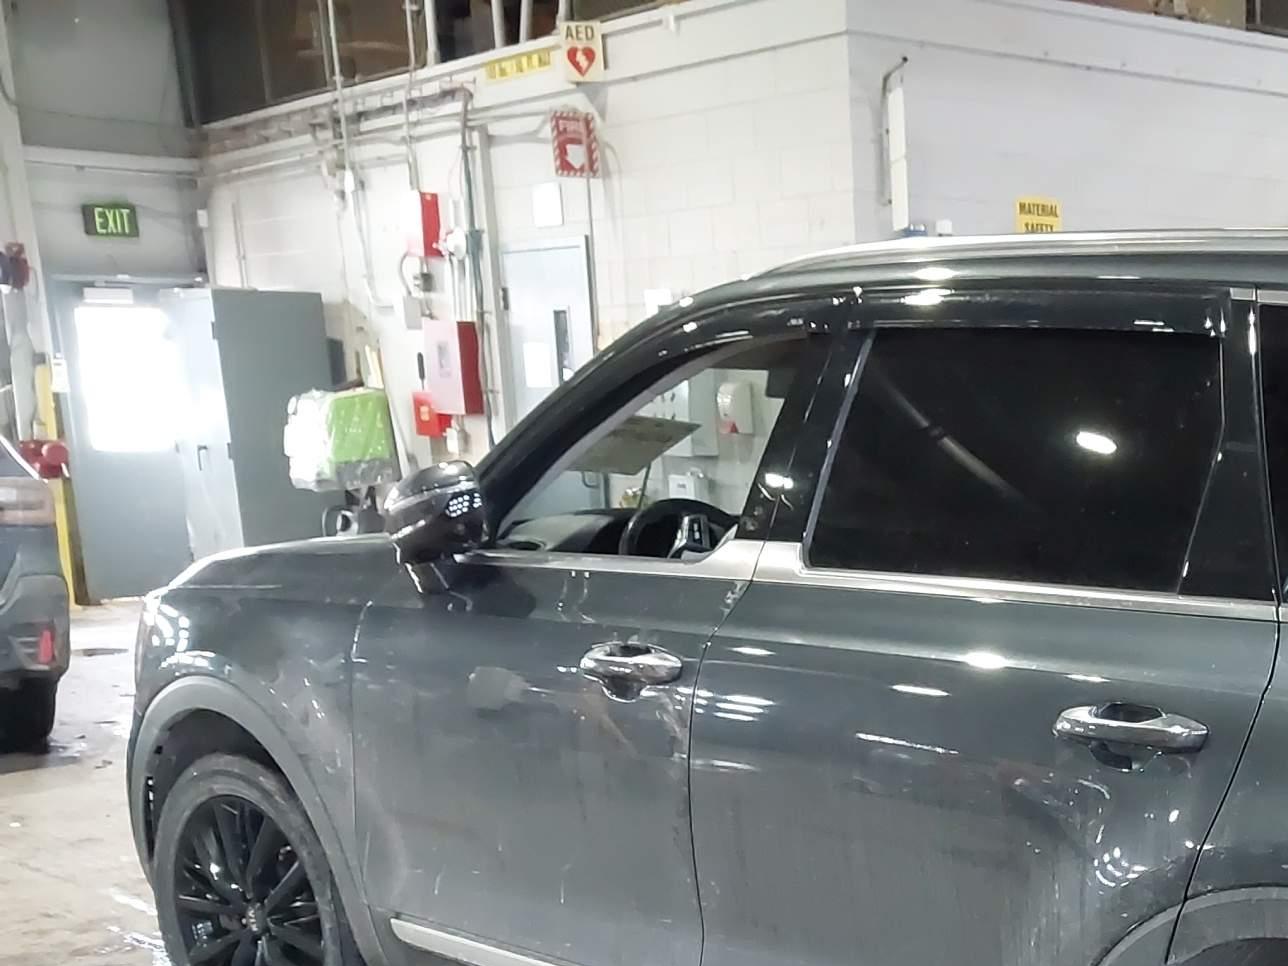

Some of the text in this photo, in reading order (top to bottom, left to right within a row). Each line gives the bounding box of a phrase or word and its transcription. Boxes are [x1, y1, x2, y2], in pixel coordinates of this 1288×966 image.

[565, 25, 594, 40] AED
[1018, 201, 1058, 217] MATERIAL
[94, 207, 130, 234] EXIT
